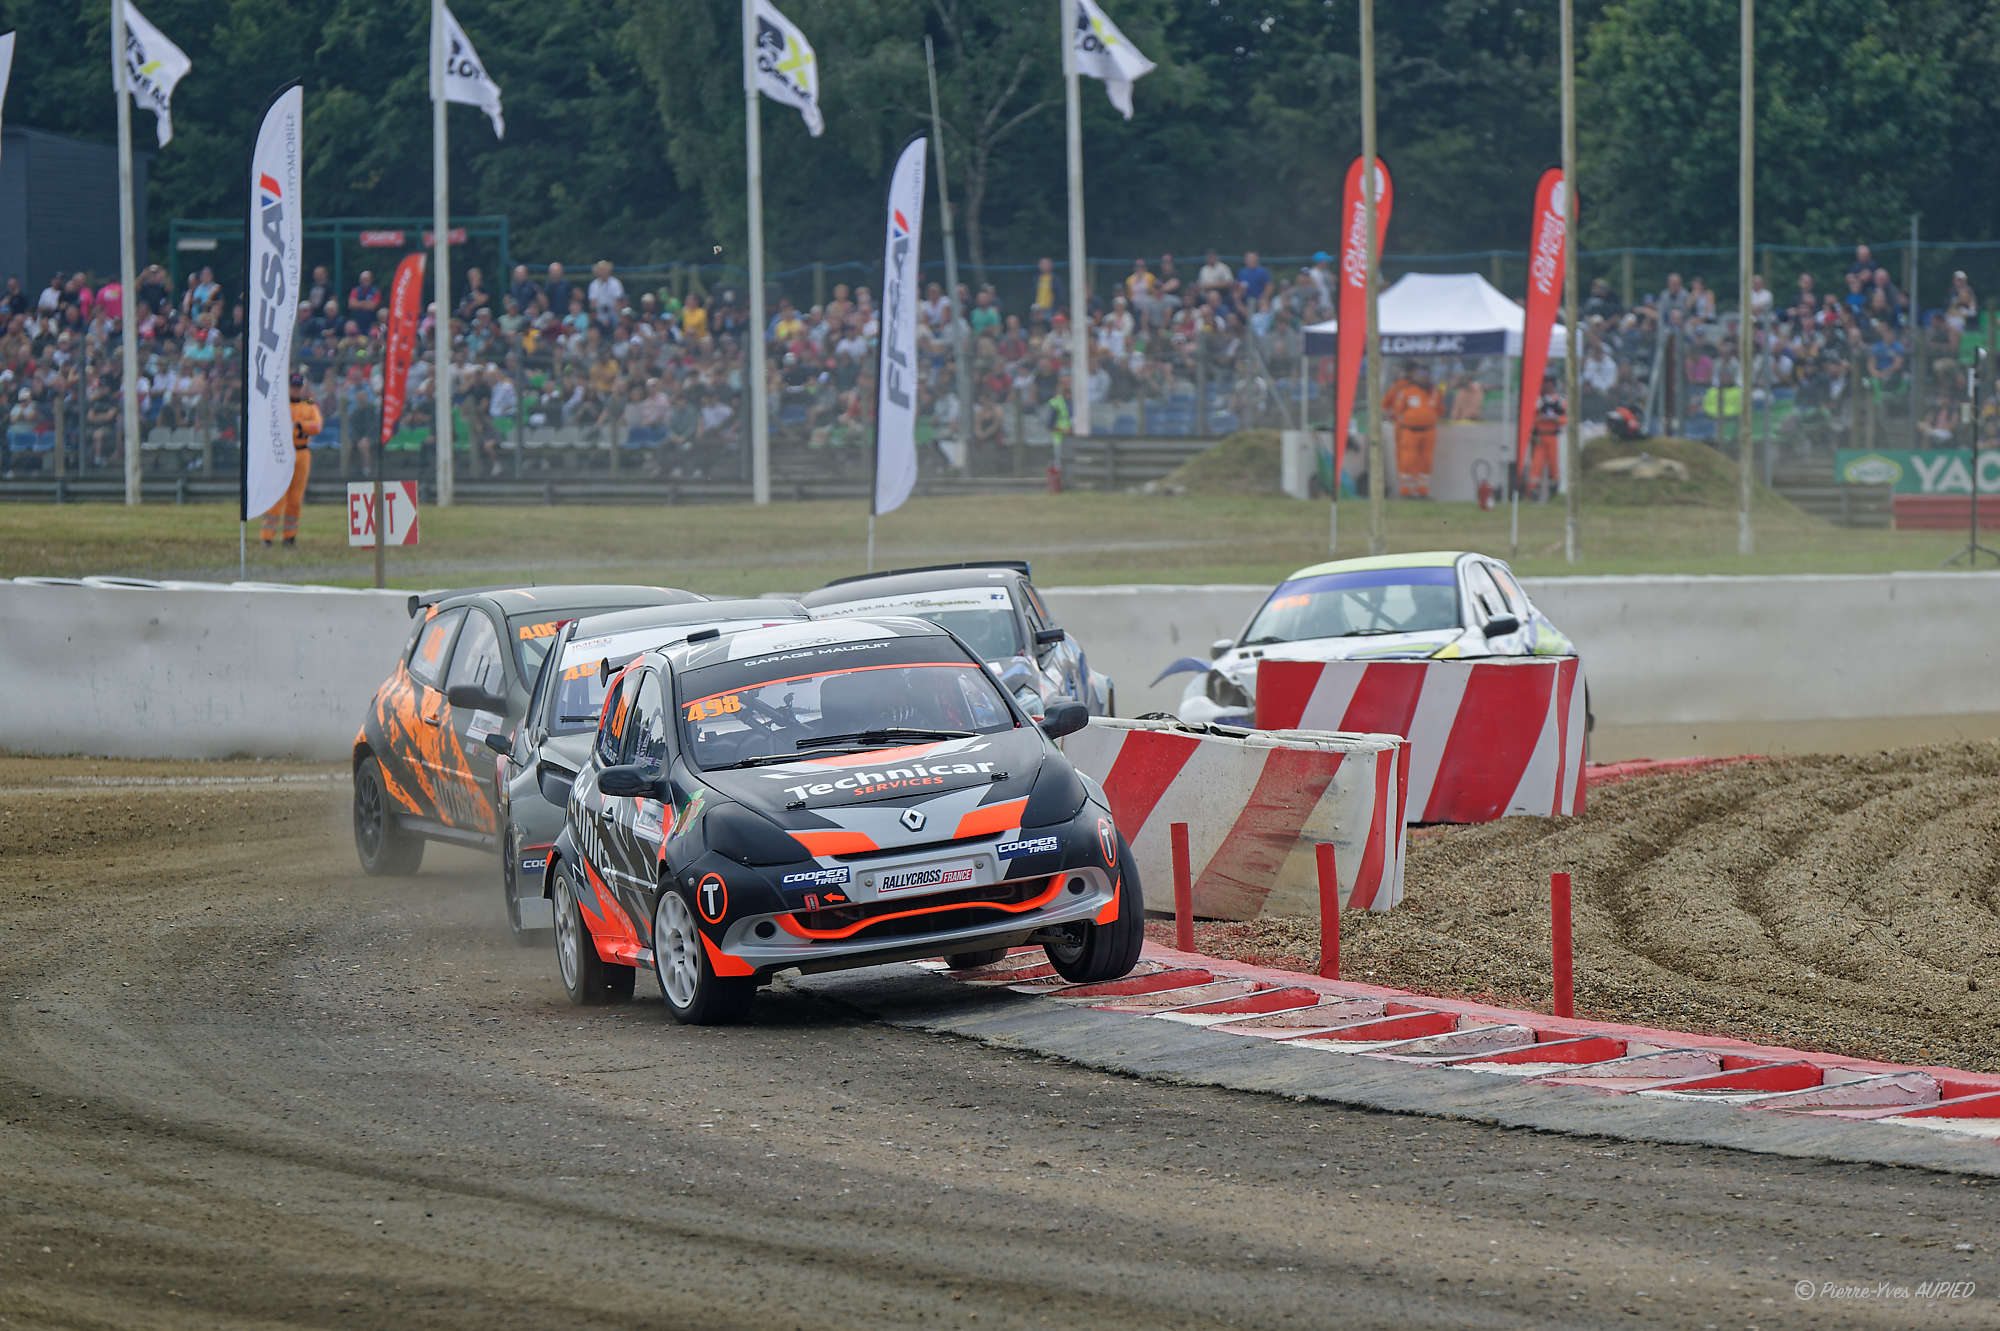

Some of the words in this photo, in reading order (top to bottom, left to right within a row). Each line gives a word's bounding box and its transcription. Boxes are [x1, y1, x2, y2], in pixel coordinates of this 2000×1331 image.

[256, 202, 286, 398] FFSA
[350, 493, 396, 536] EXT
[744, 651, 815, 667] GARAGE
[818, 642, 892, 654] MAUDUIT
[687, 695, 742, 722] 498
[784, 761, 995, 801] Technicar
[853, 776, 945, 797] SERVICES
[998, 836, 1057, 853] COOPER
[1028, 843, 1058, 854] TIRES
[783, 868, 849, 884] COOPER
[814, 876, 848, 886] TIRES
[882, 869, 942, 890] RALLYCROSS
[942, 868, 972, 883] FRANCE
[703, 884, 719, 915] T
